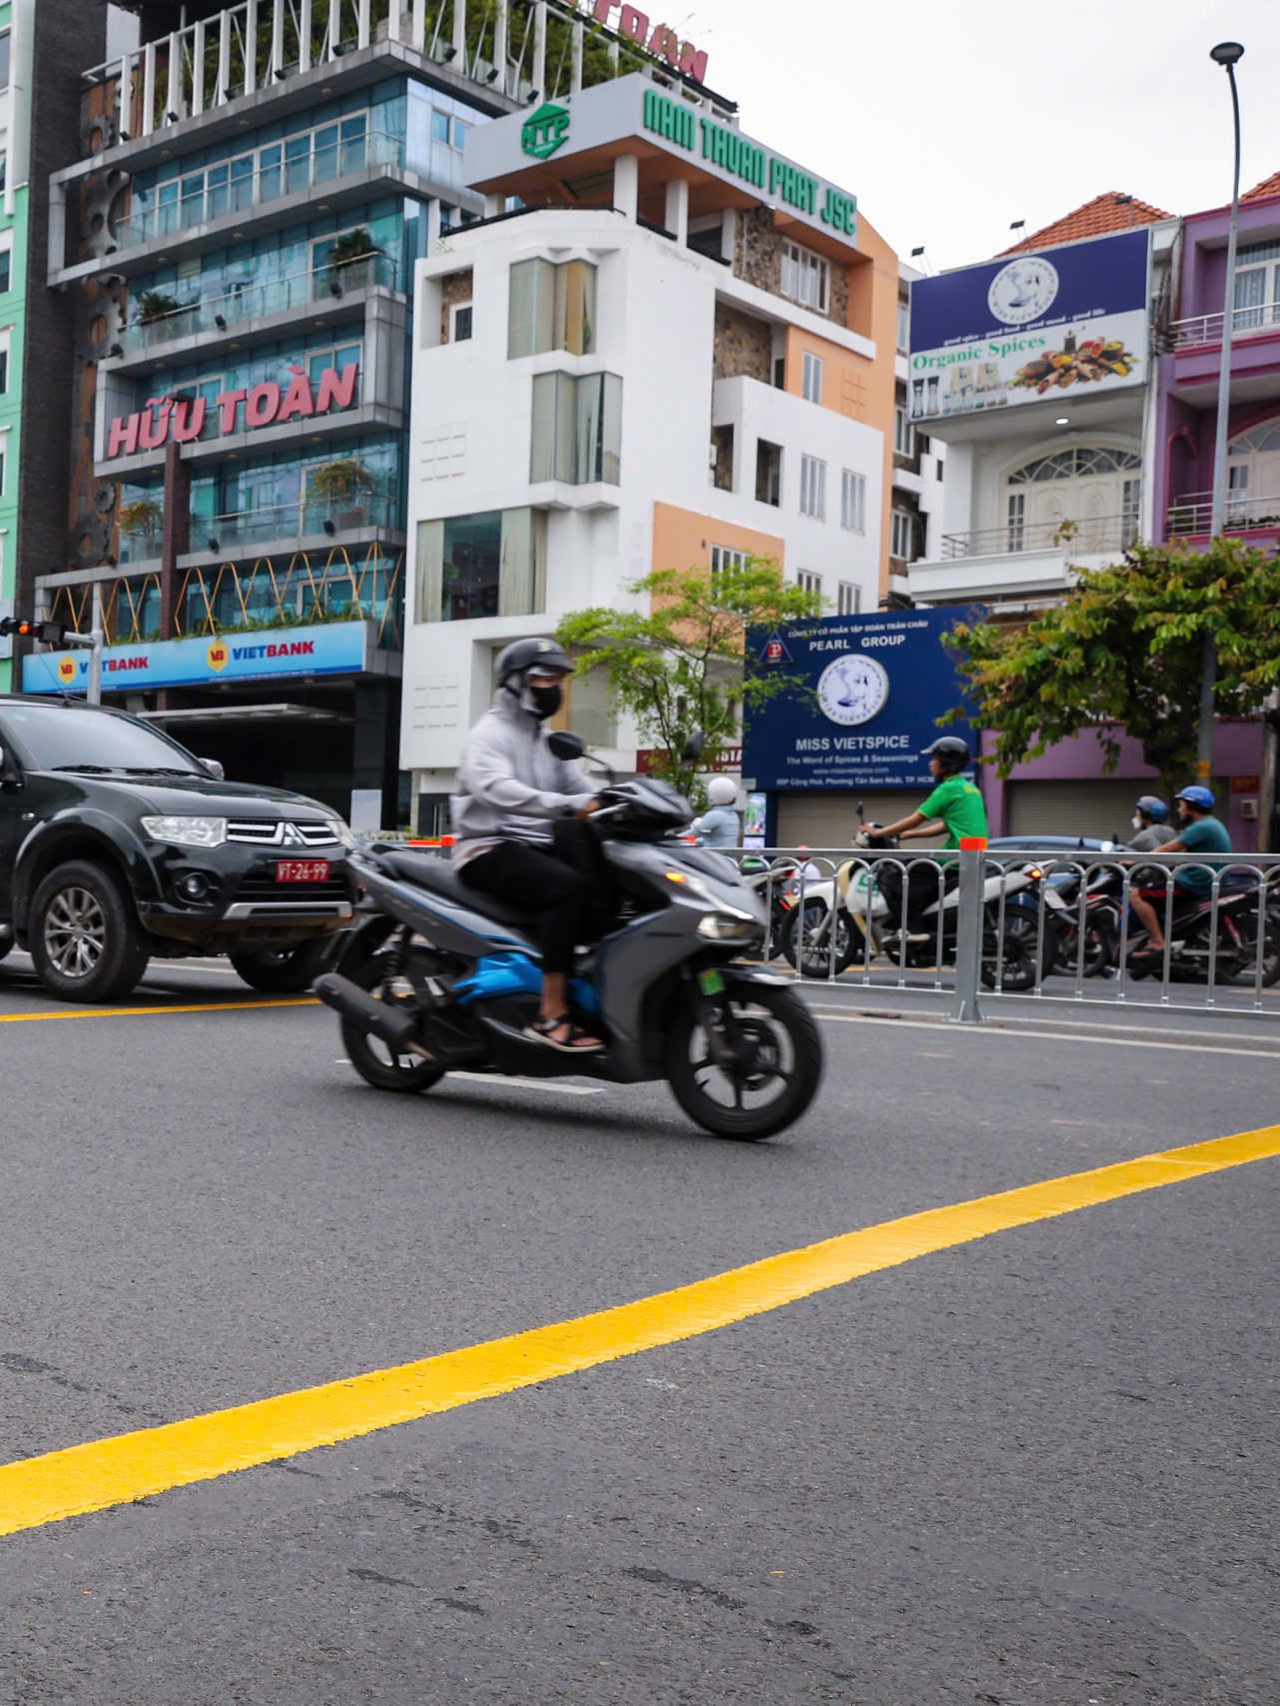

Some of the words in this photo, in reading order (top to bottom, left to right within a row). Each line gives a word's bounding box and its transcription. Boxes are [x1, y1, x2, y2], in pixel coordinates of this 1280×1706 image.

[521, 115, 570, 148] NTP
[644, 88, 695, 151] NAM
[700, 117, 766, 189] THUAN
[770, 157, 819, 216] PHAT
[820, 188, 856, 236] JSC
[913, 345, 982, 371] Organic
[987, 335, 1047, 359] Spices
[107, 395, 207, 458] HỮU
[217, 363, 359, 434] TOÀN
[232, 641, 314, 660] VIETBANK
[809, 639, 850, 651] PEARL
[861, 634, 906, 648] GROUP
[211, 650, 224, 661] VB
[80, 656, 149, 674] VTBANK
[796, 738, 830, 751] MISS
[834, 735, 910, 750] VIETSPICE
[787, 757, 801, 765] The
[824, 755, 833, 763] of
[834, 755, 861, 765] Spices
[862, 755, 869, 763] &
[870, 753, 919, 764] Seasonings
